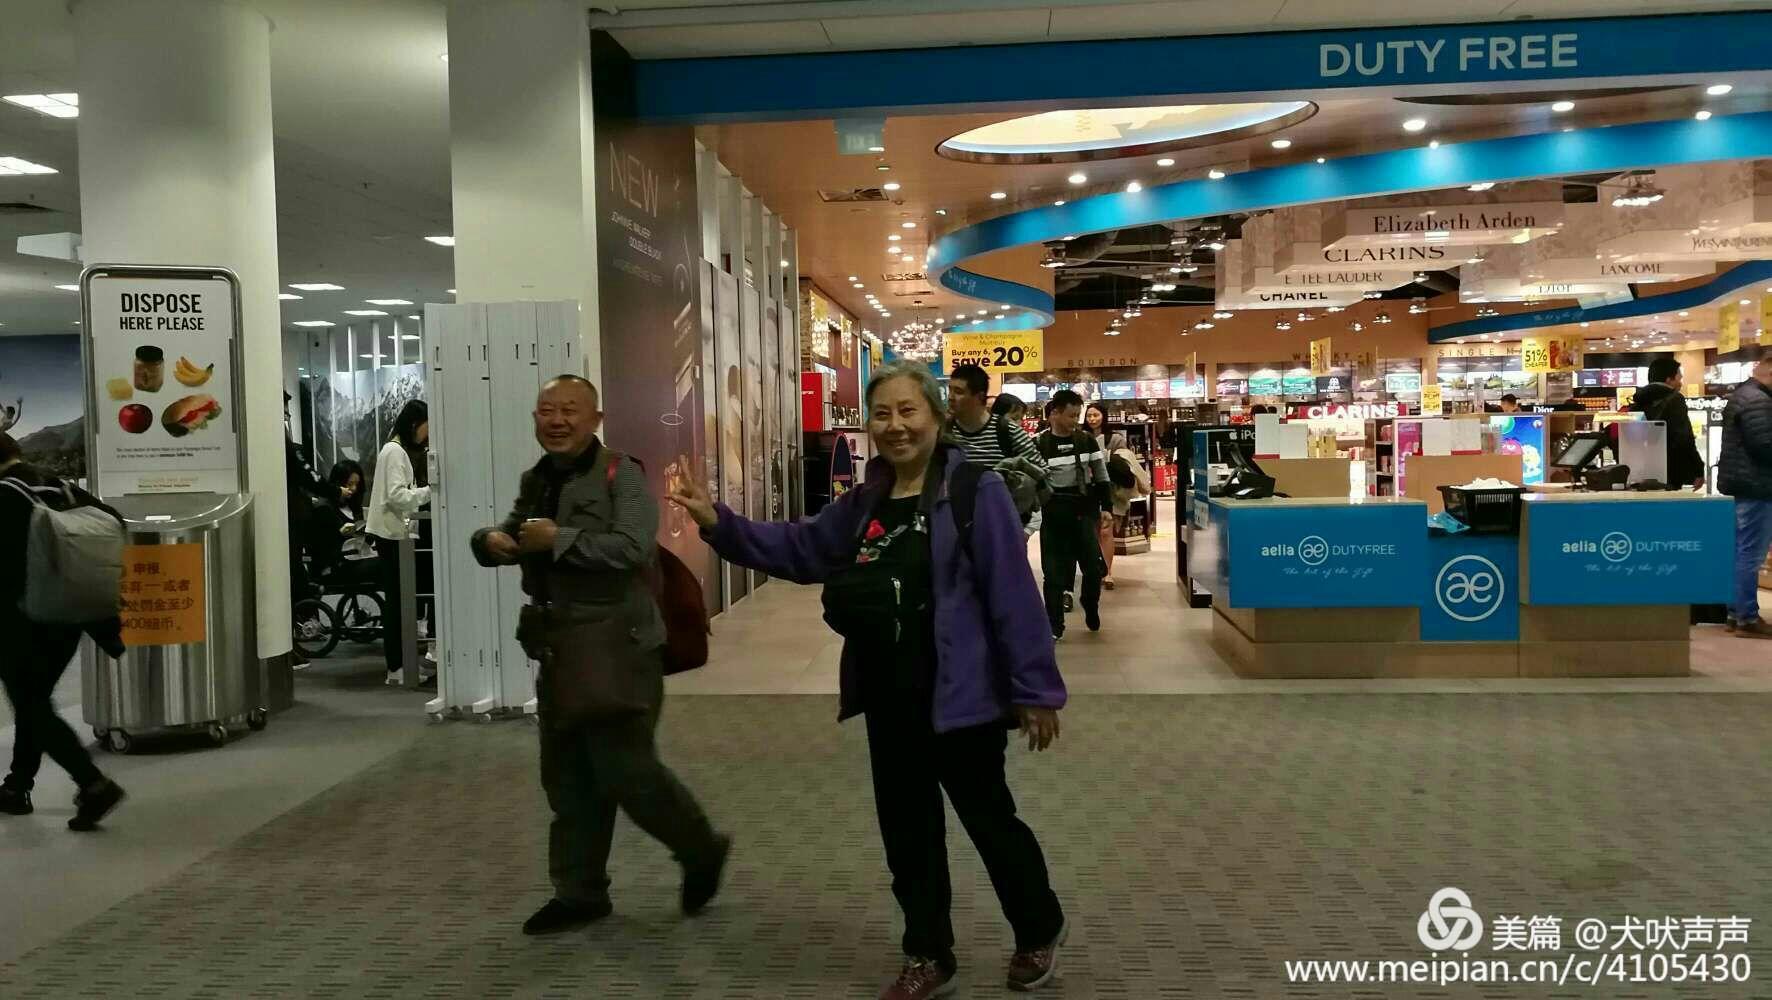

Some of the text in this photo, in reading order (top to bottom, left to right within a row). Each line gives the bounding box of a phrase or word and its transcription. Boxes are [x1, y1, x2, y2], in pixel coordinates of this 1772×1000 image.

[1319, 33, 1578, 77] DUTY FREE
[610, 141, 659, 218] NEW
[1374, 211, 1536, 233] Elizabeth Arden
[1324, 245, 1445, 263] CLARINS
[1328, 272, 1383, 283] LAUDER
[120, 293, 202, 313] DISPOSE
[119, 317, 205, 331] HERE PLEASE
[951, 349, 966, 357] Buy
[1438, 347, 1496, 357] SINGLE
[1524, 347, 1548, 362] 51%
[951, 357, 991, 368] save
[1067, 357, 1137, 367] BOURBON
[1307, 405, 1399, 419] CLARINS
[1533, 405, 1555, 413] Dior
[1261, 544, 1295, 557] aelia
[1331, 544, 1396, 556] DUTYFREE
[1561, 540, 1597, 553] aelia
[1635, 540, 1702, 553] DUTYFREE
